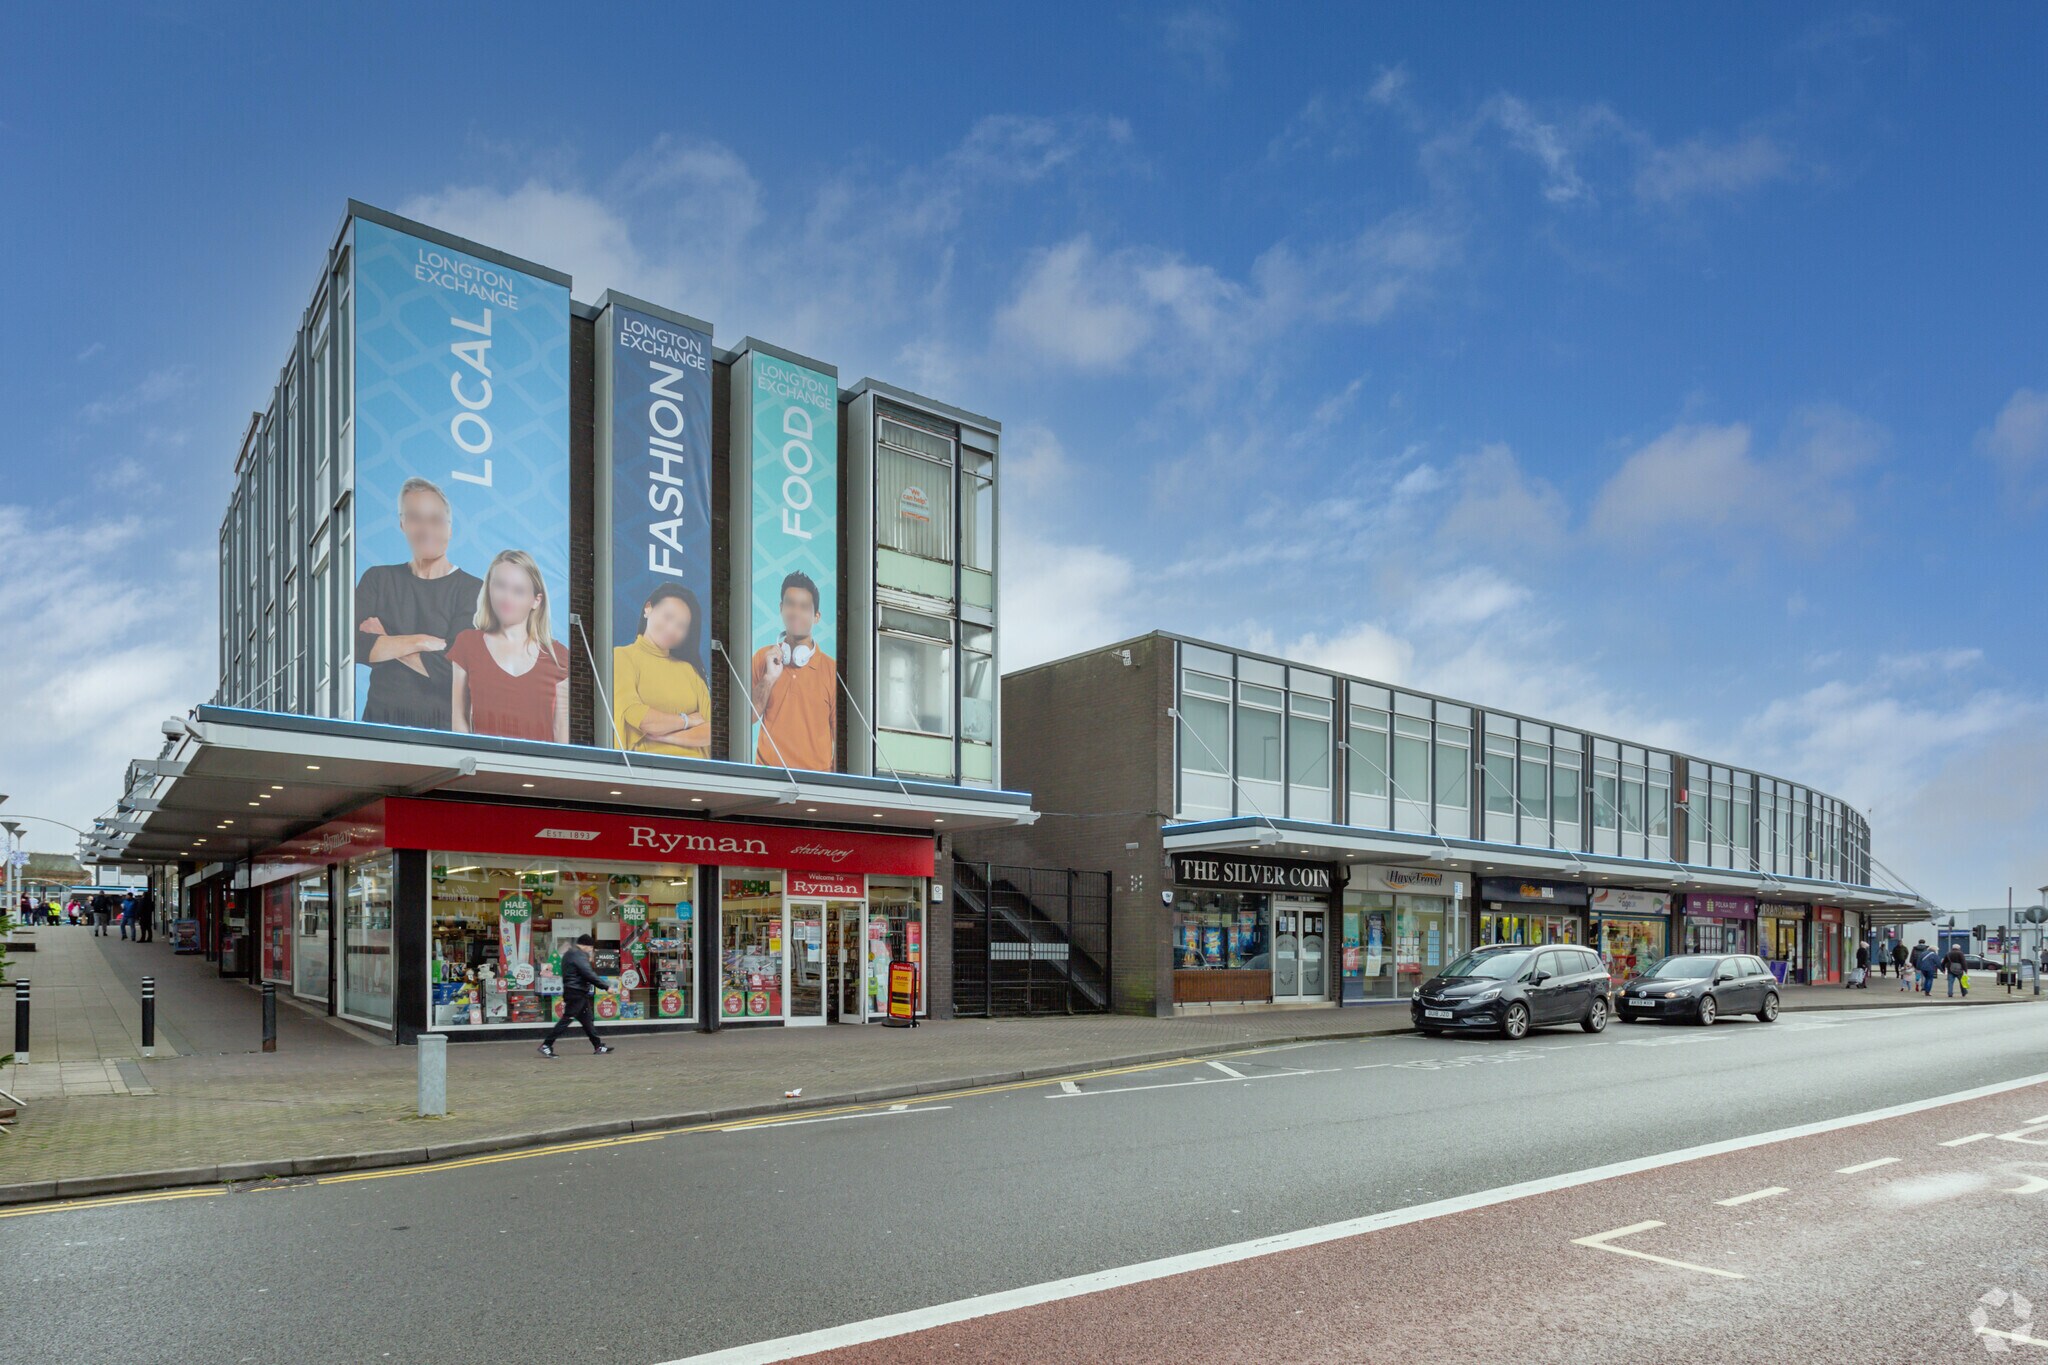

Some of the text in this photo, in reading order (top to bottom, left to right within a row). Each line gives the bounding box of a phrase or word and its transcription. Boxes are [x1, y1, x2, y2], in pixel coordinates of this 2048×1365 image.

[419, 248, 513, 293] LONGTON
[415, 264, 519, 311] EXCHANGE
[623, 317, 702, 355] LONGTON
[620, 332, 706, 371] EXCHANGE
[758, 376, 833, 411] EXCHANGE
[761, 362, 829, 396] LONGTON
[451, 308, 492, 487] LOCAL
[649, 361, 684, 577] FASHION
[783, 406, 813, 540] FOOD
[323, 829, 352, 854] Ryman
[570, 831, 590, 840] 1893
[628, 826, 769, 854] Ryman
[790, 843, 855, 863] stationery
[793, 880, 858, 894] Ryman
[808, 873, 835, 881] Welcome
[1180, 859, 1330, 888] THE SILVER COIN
[1390, 870, 1443, 886] Hays Travel
[504, 901, 527, 909] HALF
[504, 909, 528, 917] PRICE
